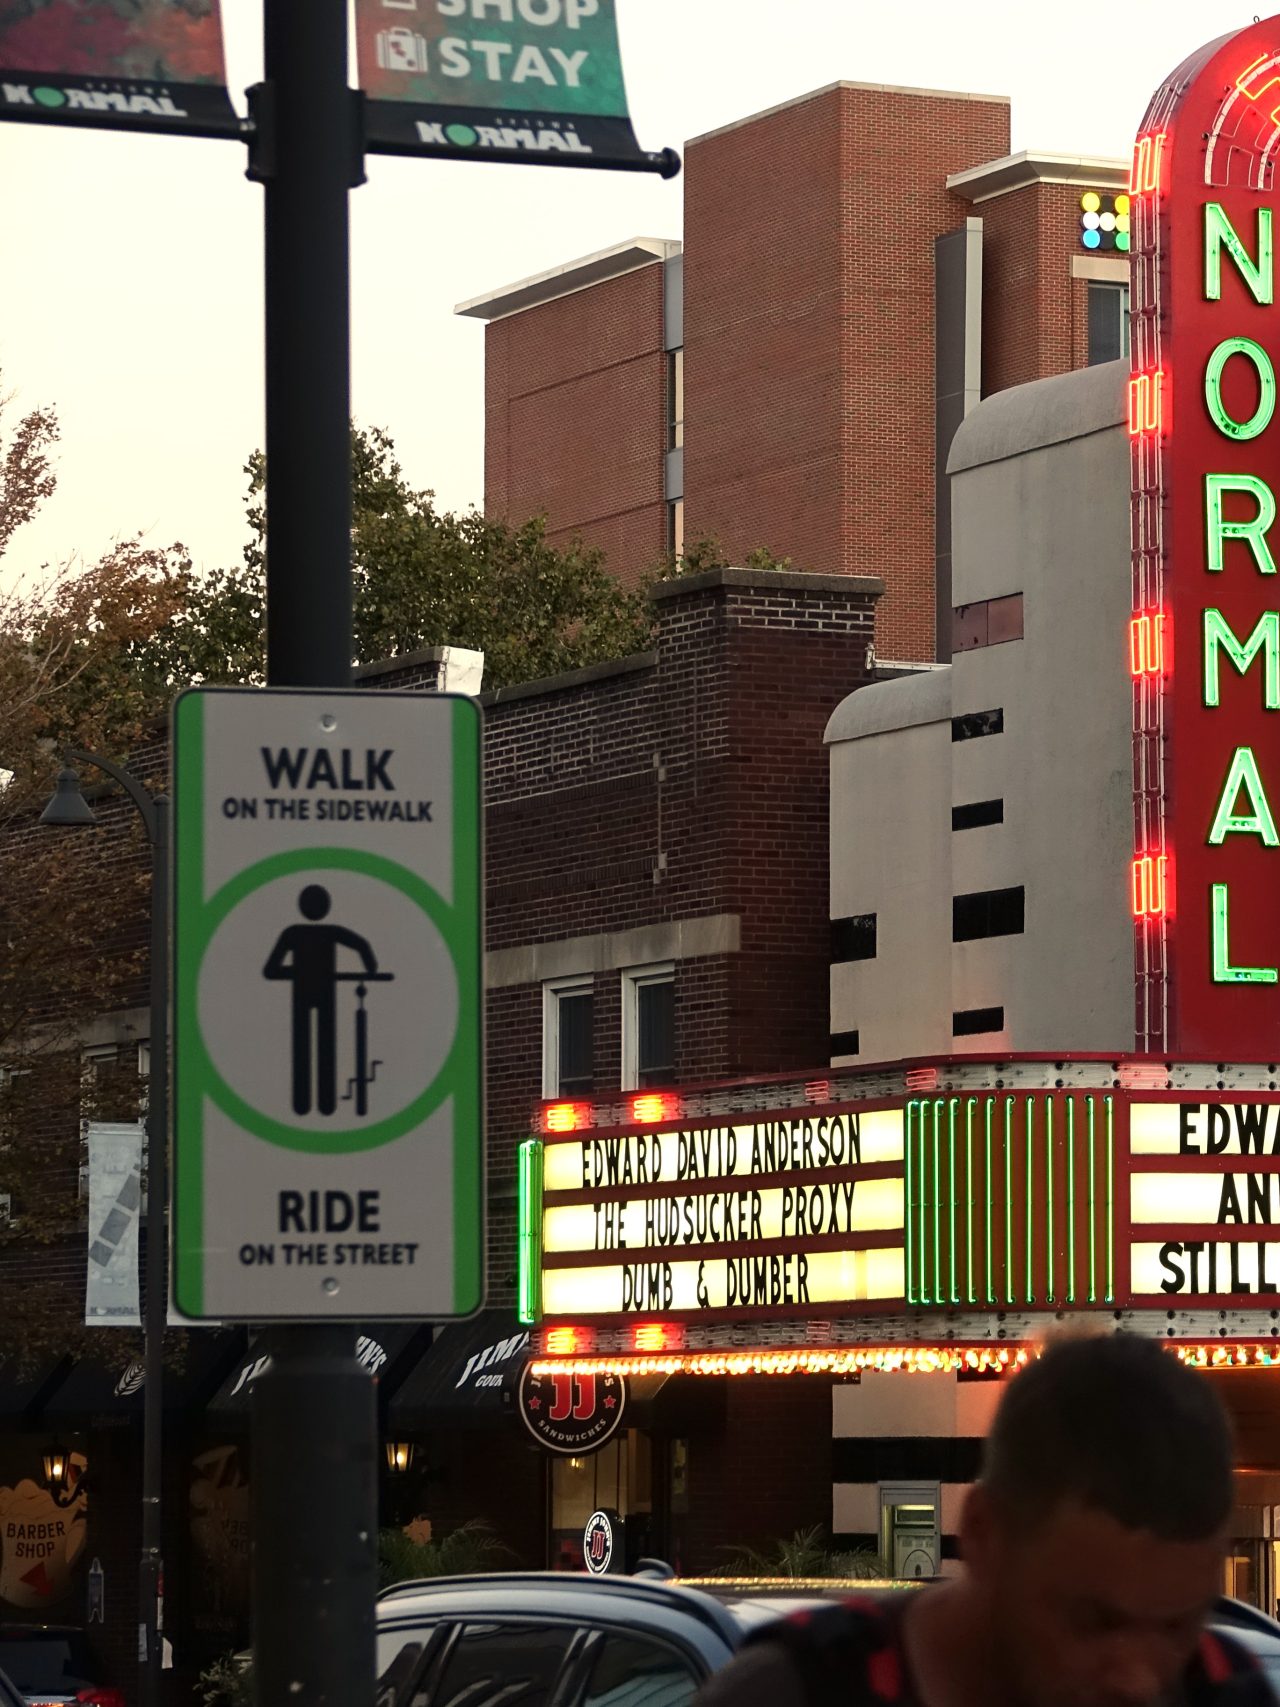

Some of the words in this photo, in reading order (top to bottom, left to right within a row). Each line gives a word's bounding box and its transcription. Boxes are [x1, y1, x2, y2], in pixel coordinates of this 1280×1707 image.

[438, 37, 589, 88] STAY
[2, 83, 188, 117] NORMAL
[415, 121, 593, 153] NORMAL
[1203, 202, 1280, 986] NORMAL
[261, 747, 396, 791] WALK
[222, 798, 259, 820] ON
[265, 798, 310, 821] THE
[316, 798, 433, 822] SIDEWALK
[582, 1135, 661, 1187] EDWARD
[677, 1124, 738, 1181] DAVID
[750, 1113, 861, 1174] ANDERSON
[278, 1190, 381, 1233] RIDE
[593, 1200, 627, 1250] THE
[644, 1190, 763, 1247] HUDSUCKER
[781, 1182, 857, 1237] PROXY
[239, 1244, 274, 1266] ON
[283, 1244, 328, 1266] THE
[334, 1244, 419, 1266] STREET
[1158, 1242, 1279, 1294] STILL
[622, 1261, 673, 1312] DUMB
[696, 1259, 711, 1308] &
[726, 1253, 810, 1306] DUMBER
[455, 1330, 530, 1389] JIM
[549, 1371, 597, 1421] JJ
[538, 1418, 607, 1442] SANDWICHES
[6, 1521, 66, 1540] BARBER
[15, 1541, 56, 1559] SHOP
[591, 1530, 606, 1560] JJ
